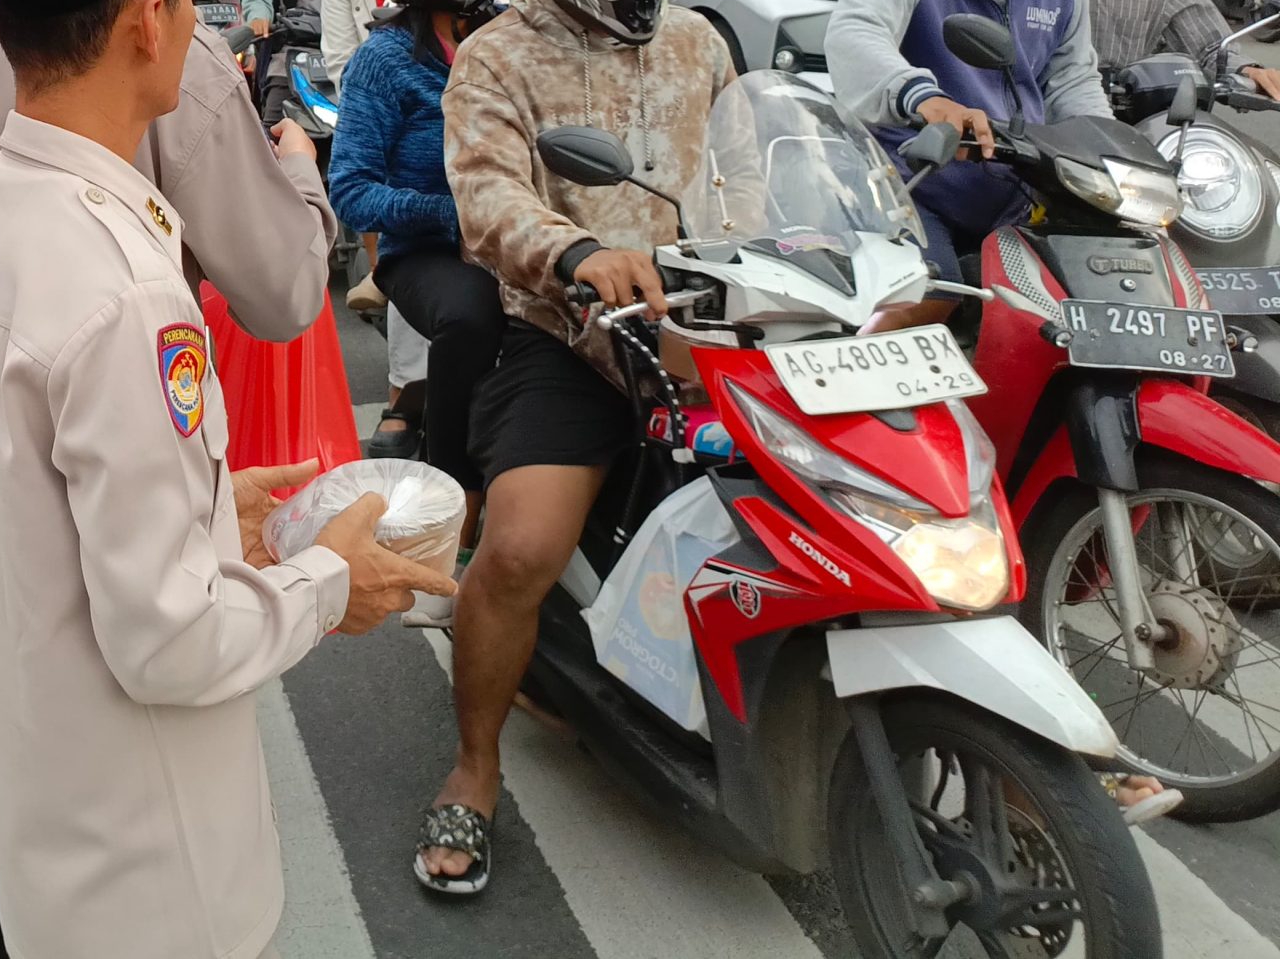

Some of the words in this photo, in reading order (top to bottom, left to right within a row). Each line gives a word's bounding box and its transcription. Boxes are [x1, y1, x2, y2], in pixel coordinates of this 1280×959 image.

[1111, 258, 1154, 274] TURBO
[1195, 272, 1258, 291] 5525
[1070, 305, 1088, 331] H
[1106, 307, 1167, 337] 2497
[1186, 315, 1218, 342] PF
[784, 348, 826, 379] AG
[836, 340, 909, 373] 4809
[913, 332, 959, 362] BX
[787, 531, 853, 588] HONDA
